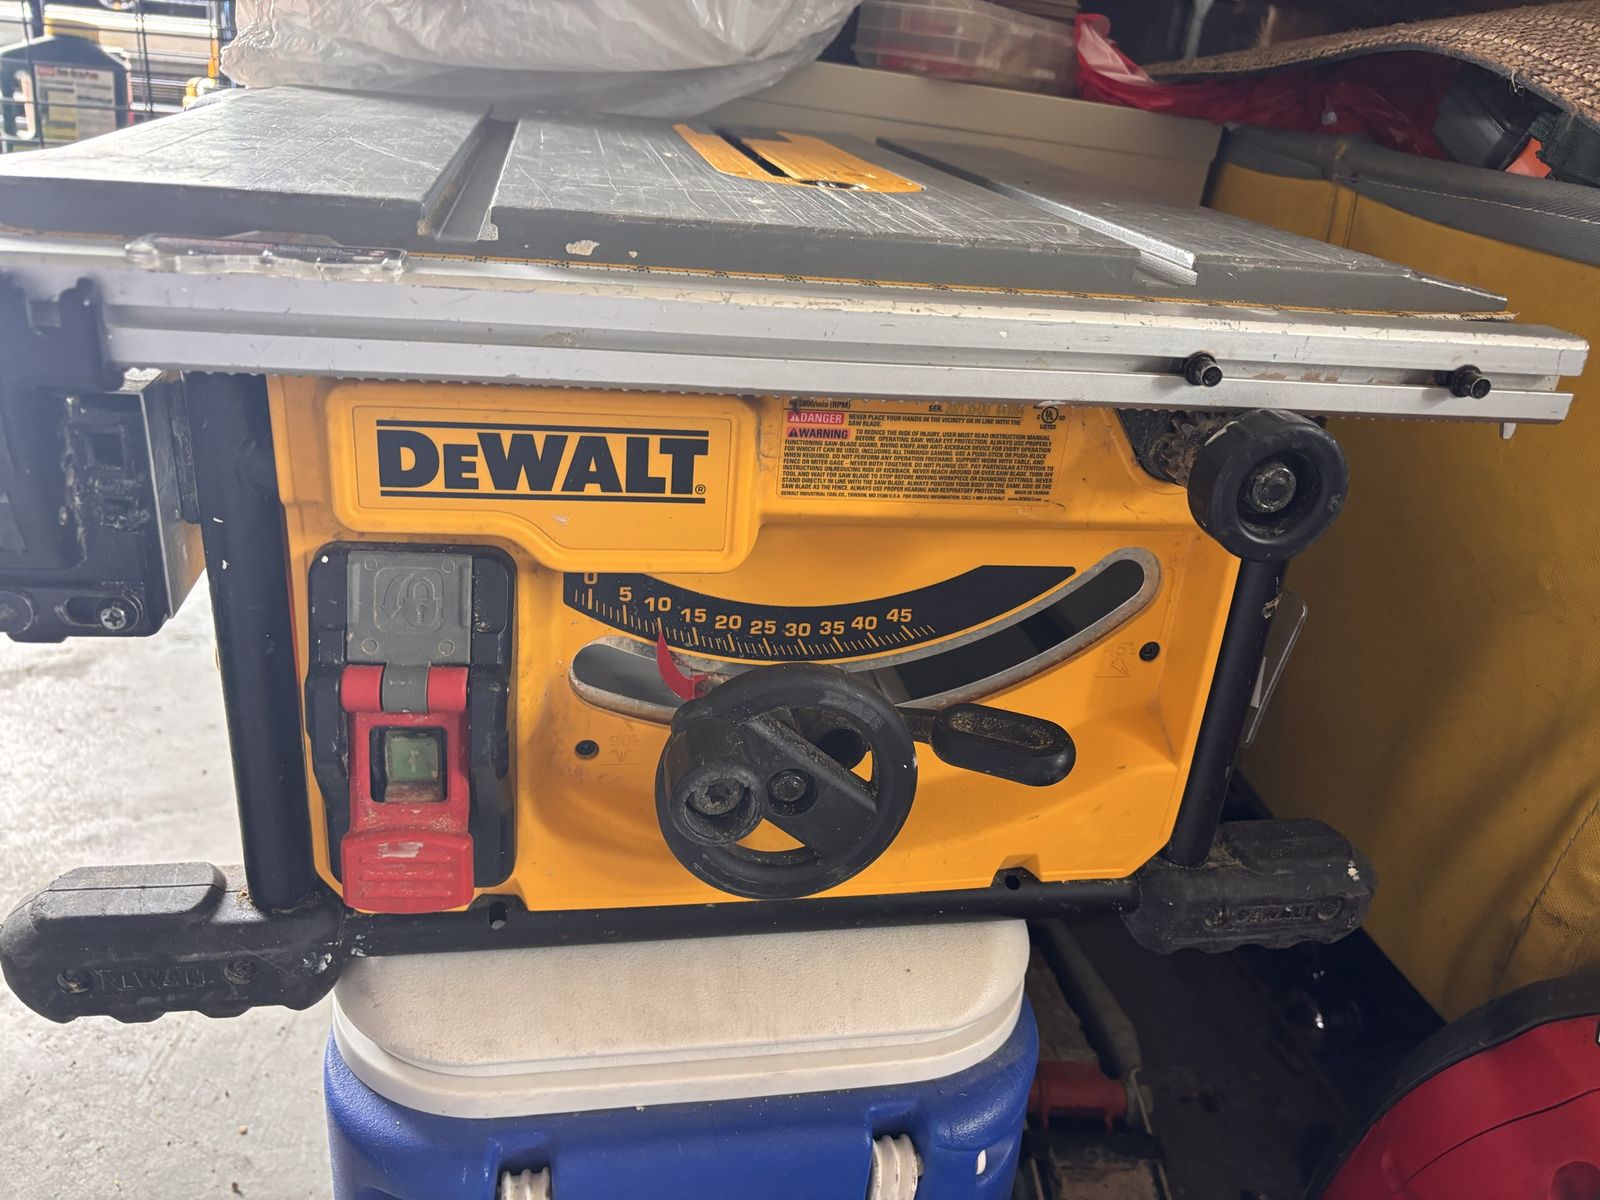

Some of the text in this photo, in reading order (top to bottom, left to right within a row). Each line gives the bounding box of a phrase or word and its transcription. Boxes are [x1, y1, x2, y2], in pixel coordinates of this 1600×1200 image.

[829, 400, 851, 409] (RPM)
[800, 413, 842, 424] DANGER
[799, 428, 848, 439] WARNING
[619, 586, 632, 602] 5
[644, 596, 672, 612] 10
[681, 608, 707, 623] 15
[714, 615, 742, 629] 20
[750, 620, 777, 634] 25
[784, 622, 811, 637] 30
[819, 620, 845, 635] 35
[850, 616, 878, 630] 40
[886, 608, 912, 622] 45
